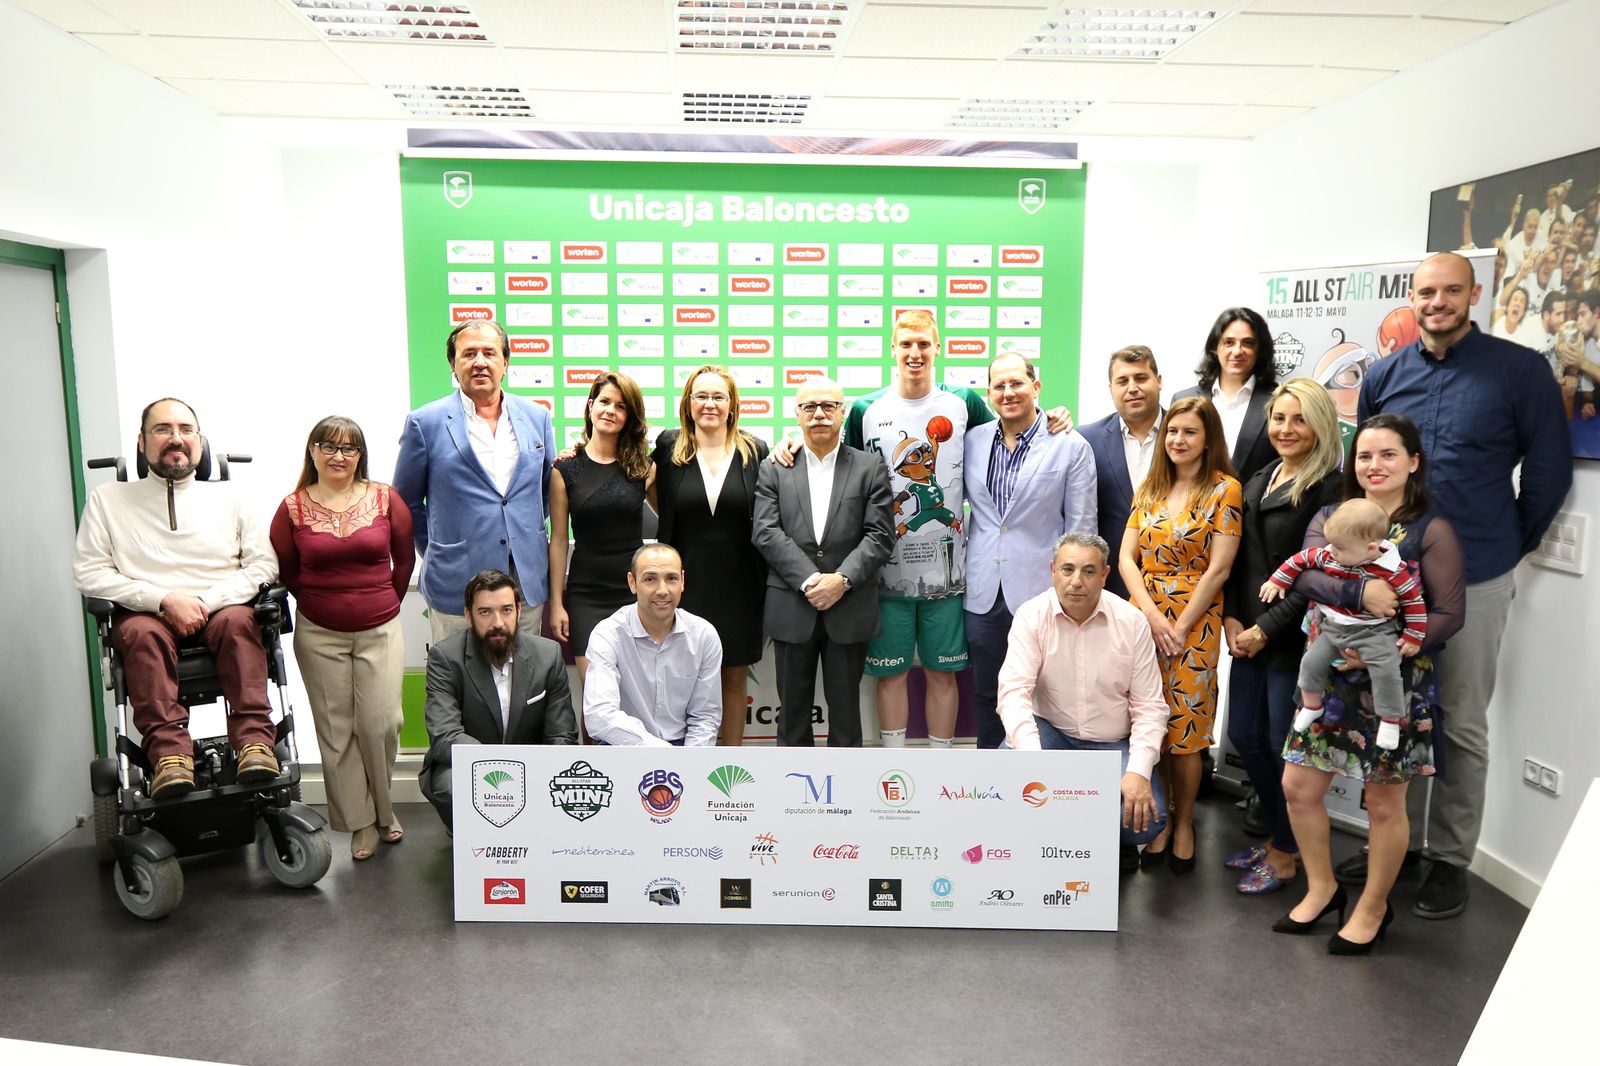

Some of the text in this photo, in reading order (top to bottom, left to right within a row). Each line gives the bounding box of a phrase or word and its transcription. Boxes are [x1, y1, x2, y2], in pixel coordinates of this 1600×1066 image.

[589, 193, 910, 227] Unicaja Baloncesto
[568, 248, 599, 257] worten
[790, 249, 821, 258] worten
[1005, 252, 1036, 260] worten
[512, 279, 543, 288] worten
[735, 280, 766, 289] worten
[953, 282, 983, 291] worten
[1266, 277, 1288, 304] 15
[1293, 279, 1320, 303] ALL
[457, 310, 488, 319] worten
[680, 311, 711, 320] worten
[1326, 306, 1347, 317] MAYO
[513, 341, 545, 350] worten
[735, 342, 766, 351] worten
[951, 342, 982, 352] worten
[938, 784, 1005, 801] Andalucía
[1074, 789, 1086, 797] DEL
[483, 793, 515, 802] Unicaja
[550, 789, 612, 806] MINI
[707, 800, 756, 809] Fundación
[784, 807, 817, 816] diputación
[826, 807, 853, 817] málaga
[714, 812, 748, 824] Unicaja
[485, 846, 529, 858] CABBERTY
[812, 843, 861, 860] Coca-Cola
[890, 846, 932, 856] DELTA
[1041, 846, 1091, 859] 101tv.es
[579, 885, 605, 894] COFER
[772, 889, 821, 897] serunion
[875, 893, 894, 901] SANTA
[987, 889, 1015, 901] AO
[1043, 889, 1072, 906] enPie
[872, 899, 898, 908] CRISTINA
